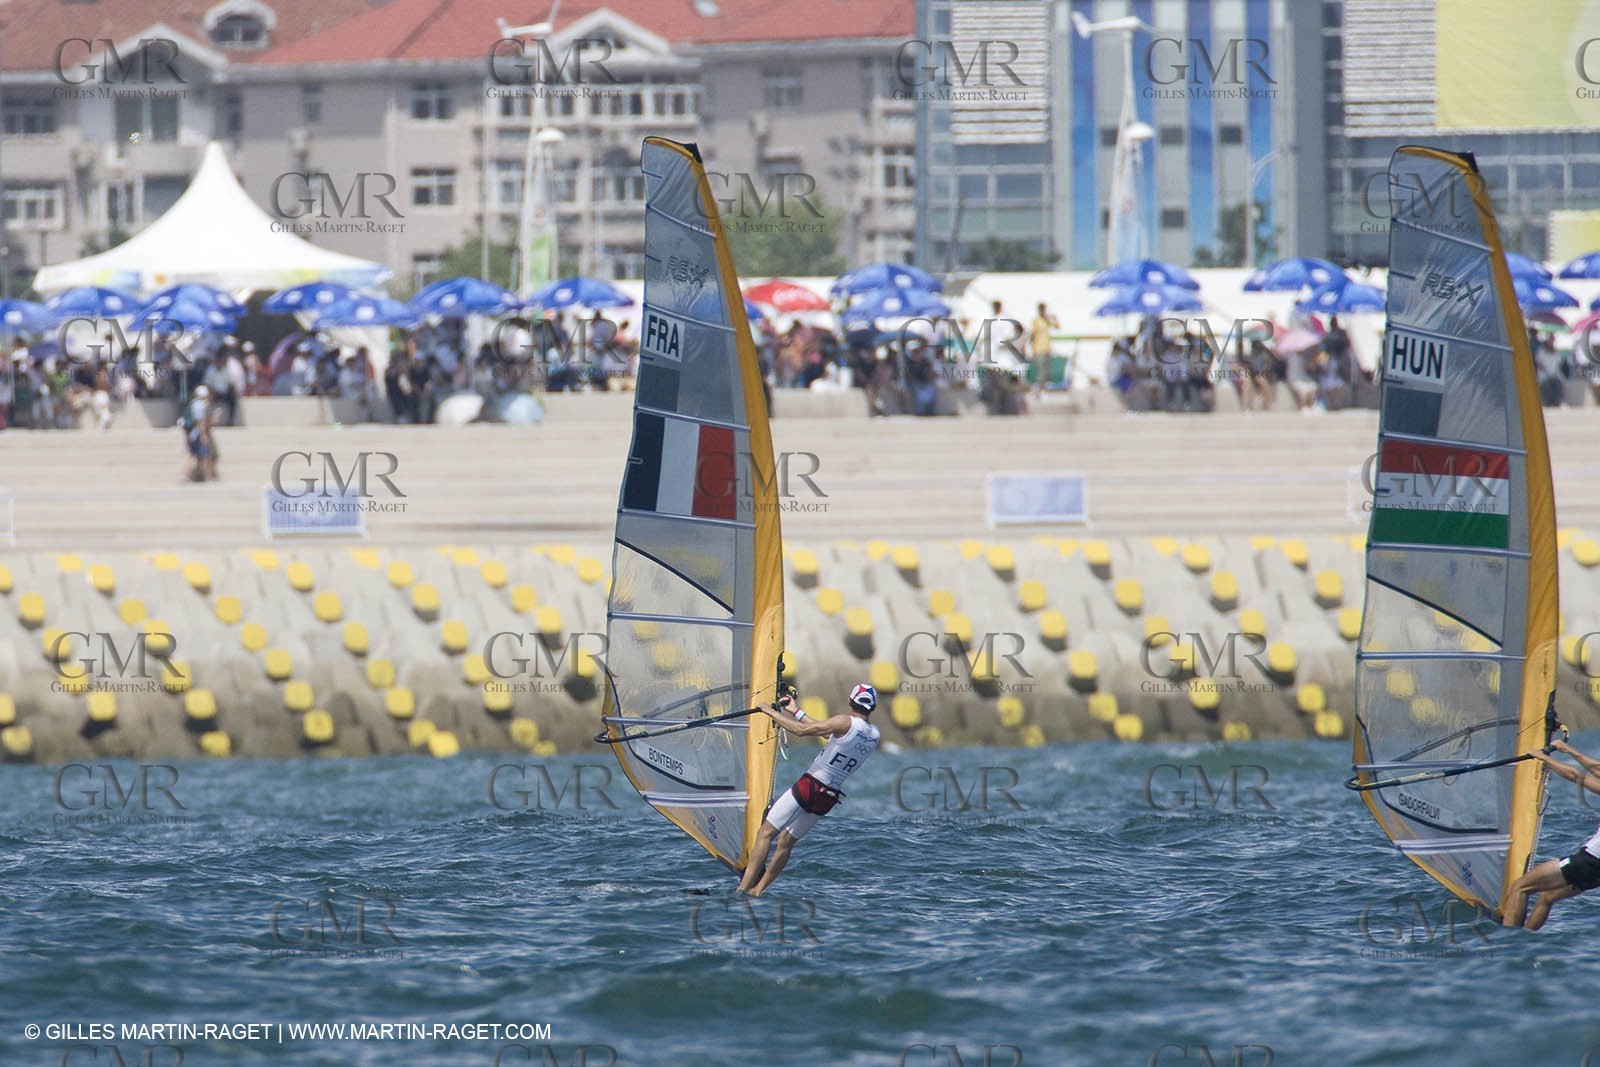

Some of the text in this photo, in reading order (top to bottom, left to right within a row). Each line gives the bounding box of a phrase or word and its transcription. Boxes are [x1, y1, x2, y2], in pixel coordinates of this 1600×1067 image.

[646, 314, 679, 358] FRA
[1391, 334, 1444, 379] HUN
[648, 747, 684, 776] BONTEMPS
